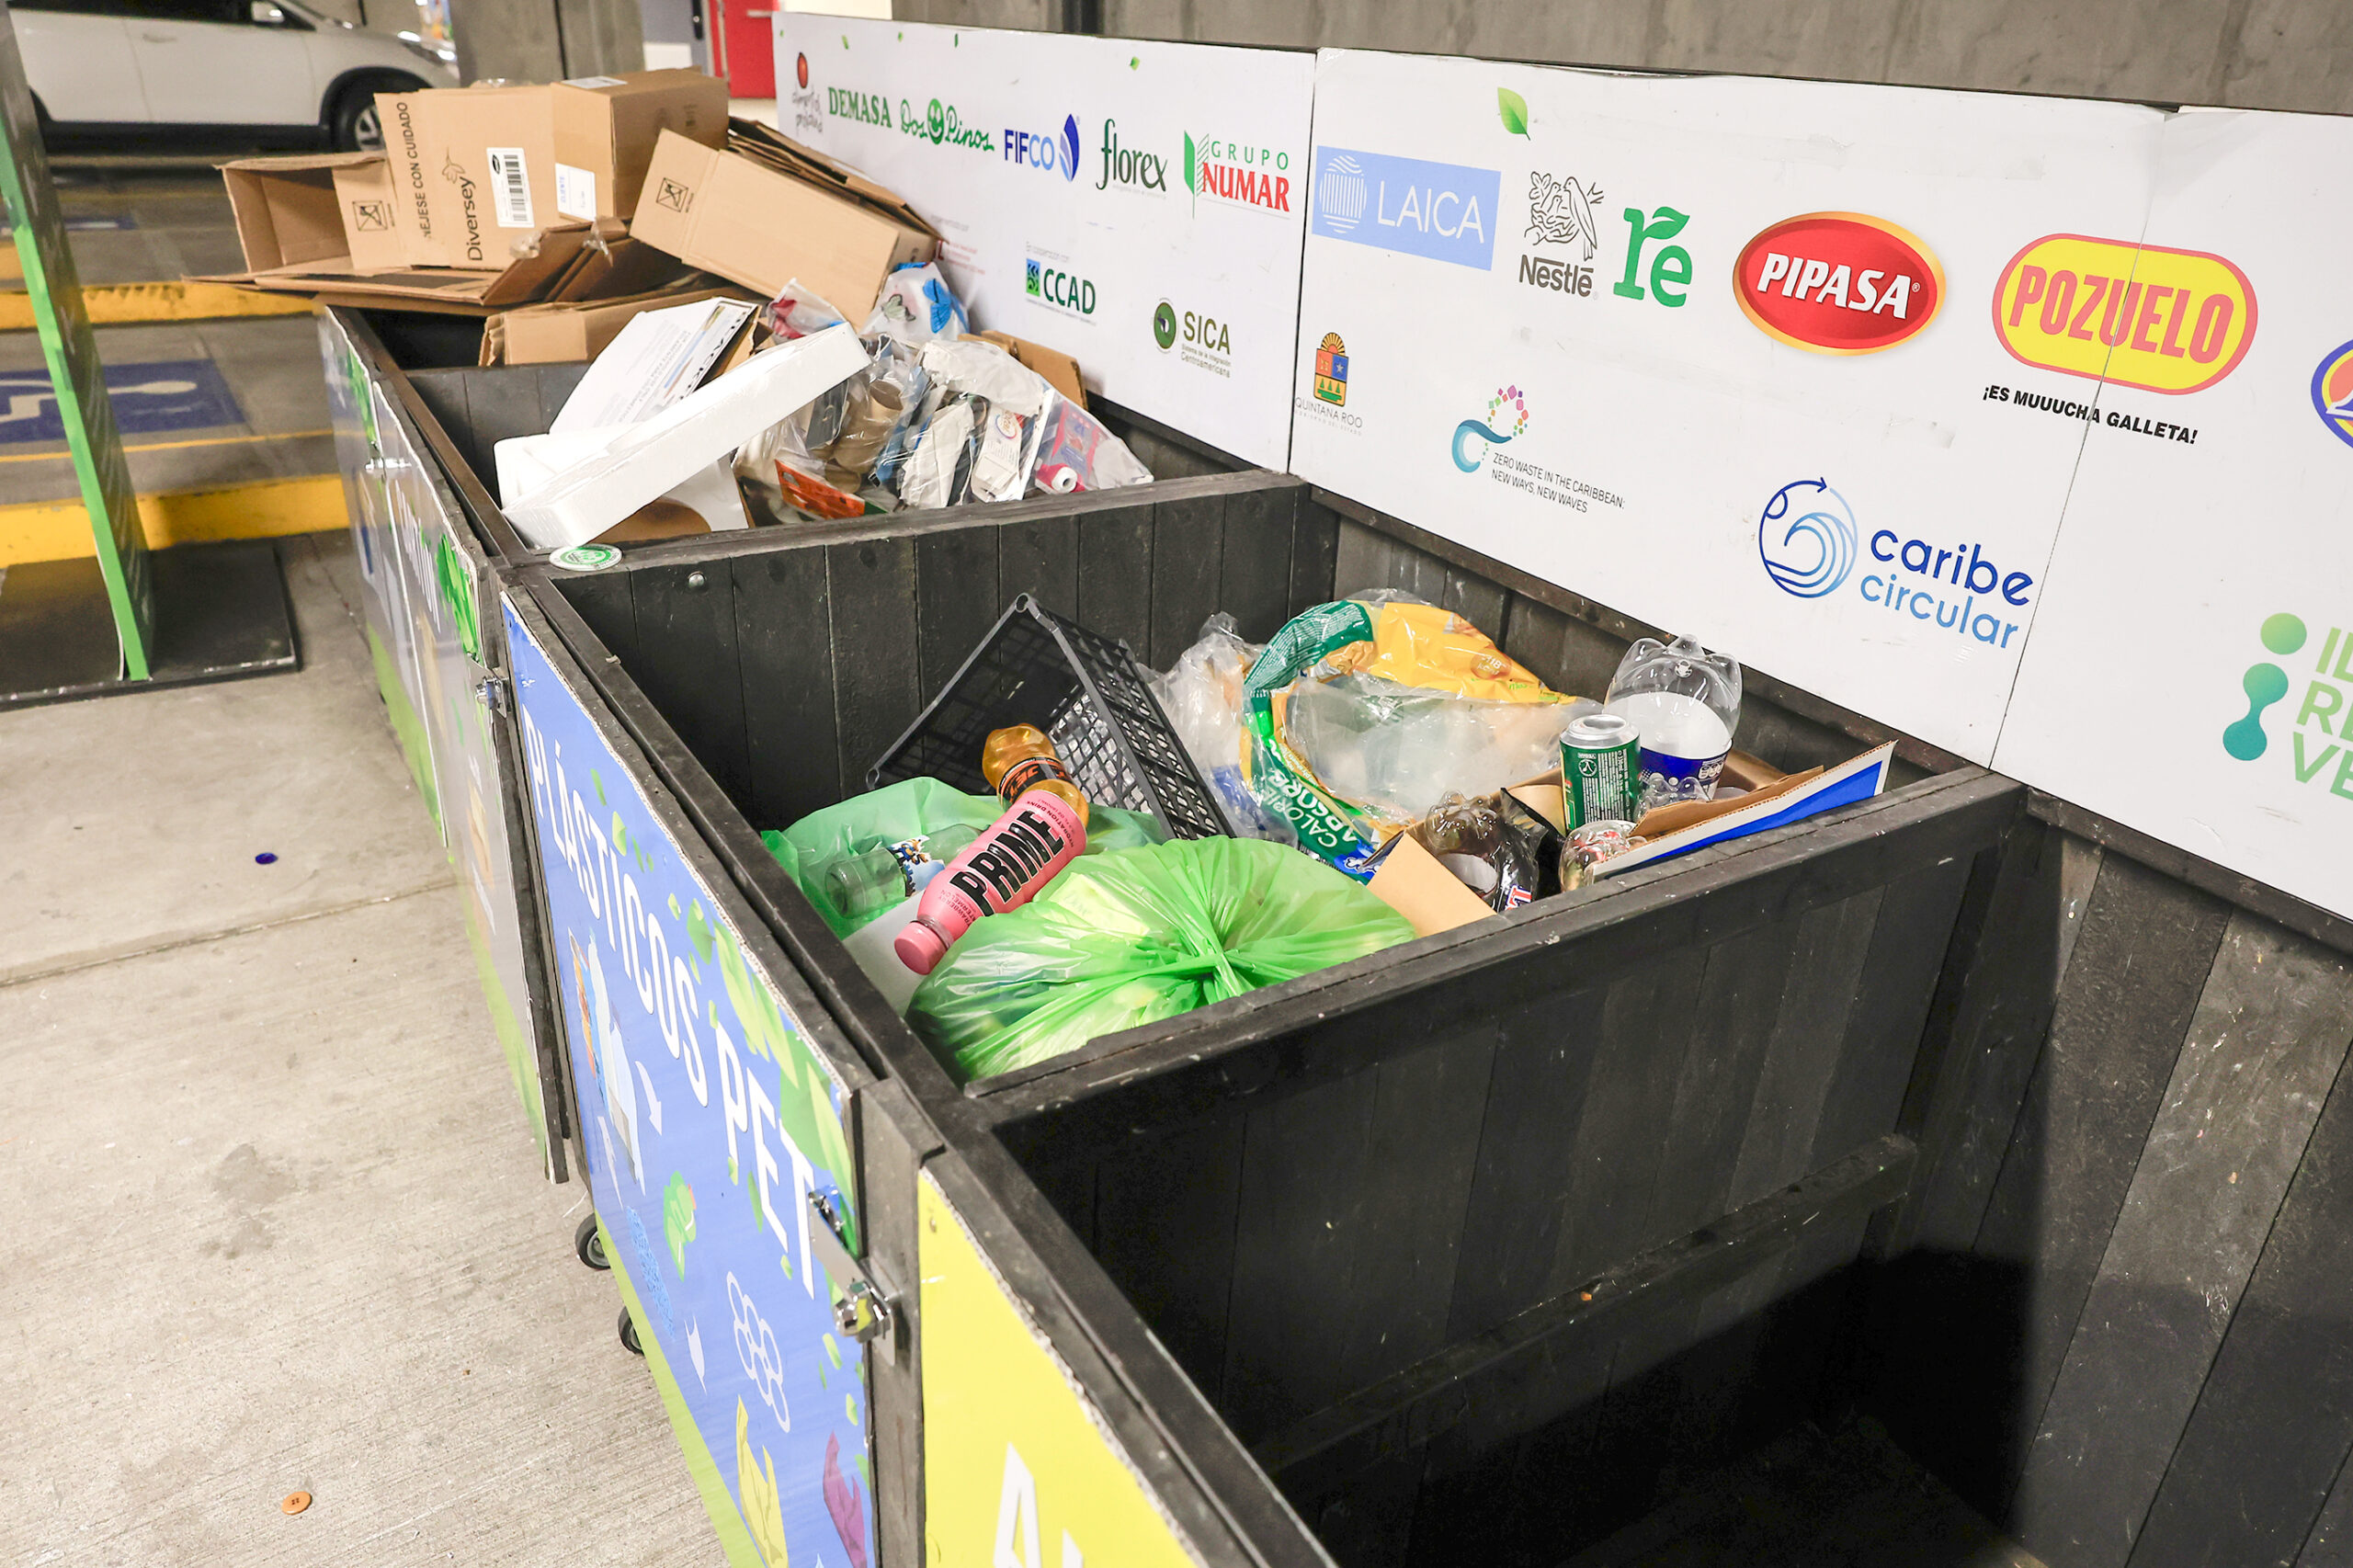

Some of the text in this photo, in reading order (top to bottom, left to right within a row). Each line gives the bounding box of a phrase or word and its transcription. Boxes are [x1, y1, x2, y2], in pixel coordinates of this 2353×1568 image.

[396, 102, 418, 159] CUIDADO
[828, 87, 892, 128] DEMASA
[901, 99, 995, 151] Dos Pinos
[412, 163, 424, 189] CON
[1005, 129, 1055, 171] FIFCO
[1096, 119, 1168, 192] florex
[1211, 141, 1290, 170] GRUPO
[1202, 162, 1290, 212] NUMAR
[1377, 181, 1485, 244] LAICA
[460, 176, 483, 261] Diversey
[1043, 268, 1096, 314] CCAD
[1756, 252, 1913, 321] PIPASA
[2007, 264, 2235, 364] POZUELO
[1183, 311, 1230, 355] SICA
[1295, 397, 1363, 428] QUINTANA ROO
[1983, 385, 2199, 445] ¡ES MUUUCHA GALLETA!
[1492, 469, 1588, 513] NEW WAYS, NEW WAVES
[1493, 452, 1625, 509] ZERO WASTE IN THE CARIBBEAN:
[1870, 529, 2034, 607] caribe
[1859, 573, 2019, 650] circular
[949, 810, 1065, 917] PRIME
[522, 704, 709, 1108] PLÁSTICOS
[715, 1020, 816, 1301] PET
